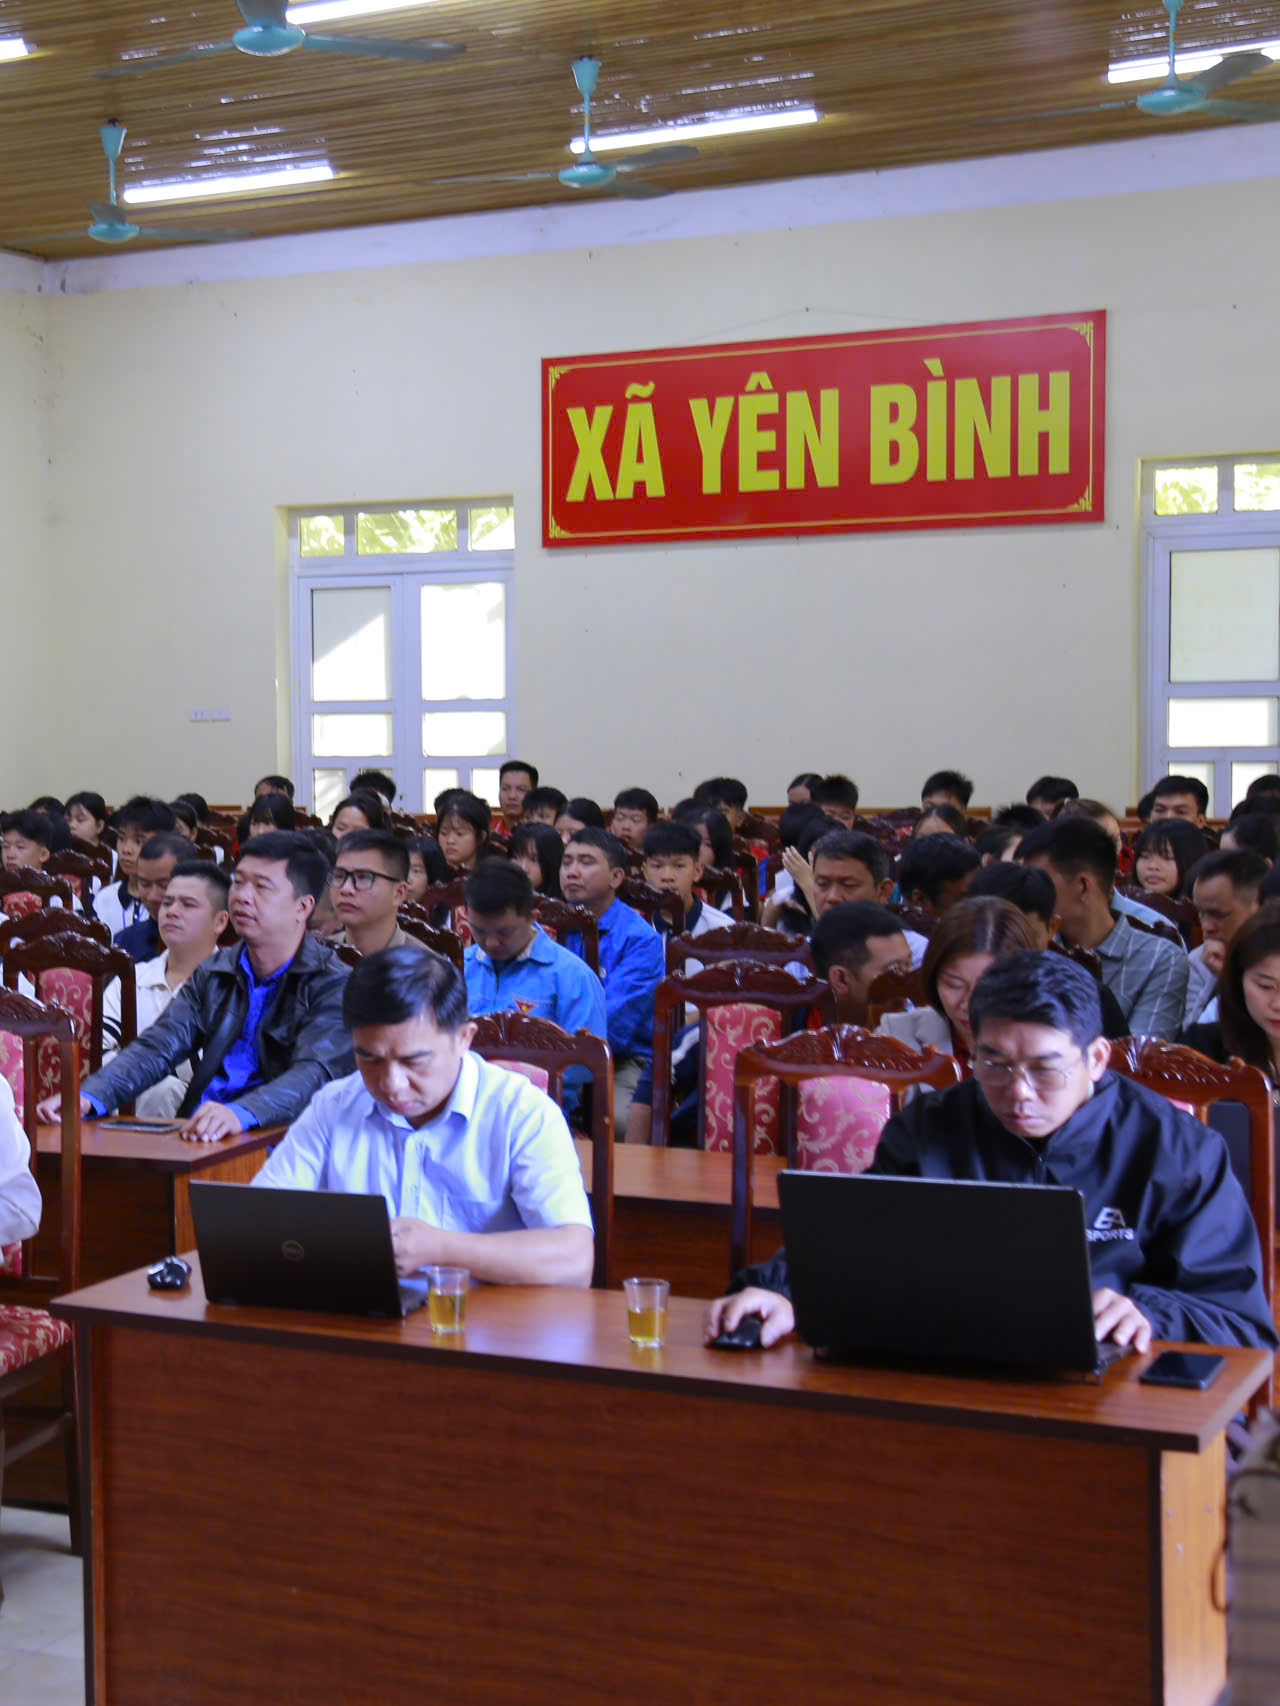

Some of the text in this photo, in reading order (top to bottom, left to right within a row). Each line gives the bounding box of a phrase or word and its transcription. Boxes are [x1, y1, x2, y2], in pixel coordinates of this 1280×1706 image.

[566, 358, 1070, 502] XÃ YÊN BÌNH
